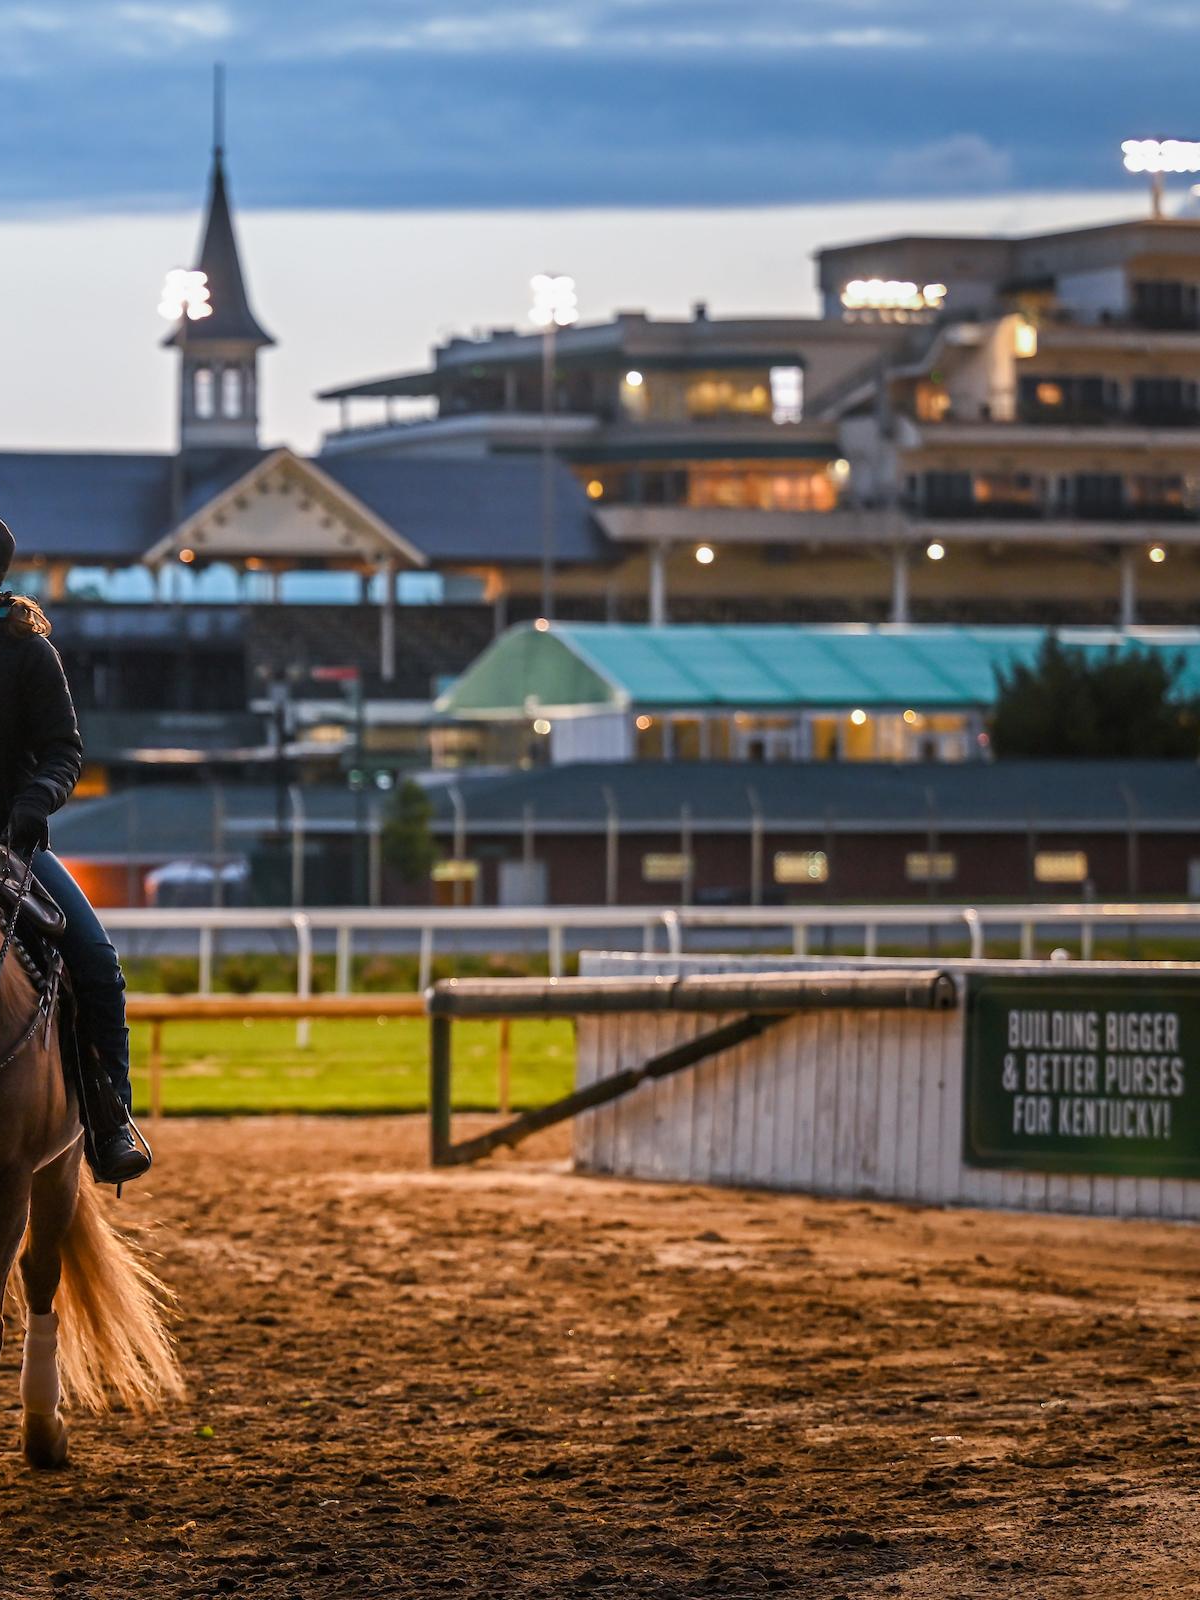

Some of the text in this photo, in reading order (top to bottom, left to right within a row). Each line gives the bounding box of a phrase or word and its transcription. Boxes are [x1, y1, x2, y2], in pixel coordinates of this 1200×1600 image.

[1008, 1010, 1179, 1051] BUILDING BIGGER
[1002, 1053, 1184, 1096] & BETTER PURSES
[1013, 1096, 1171, 1140] FOR KENTUCKY!
